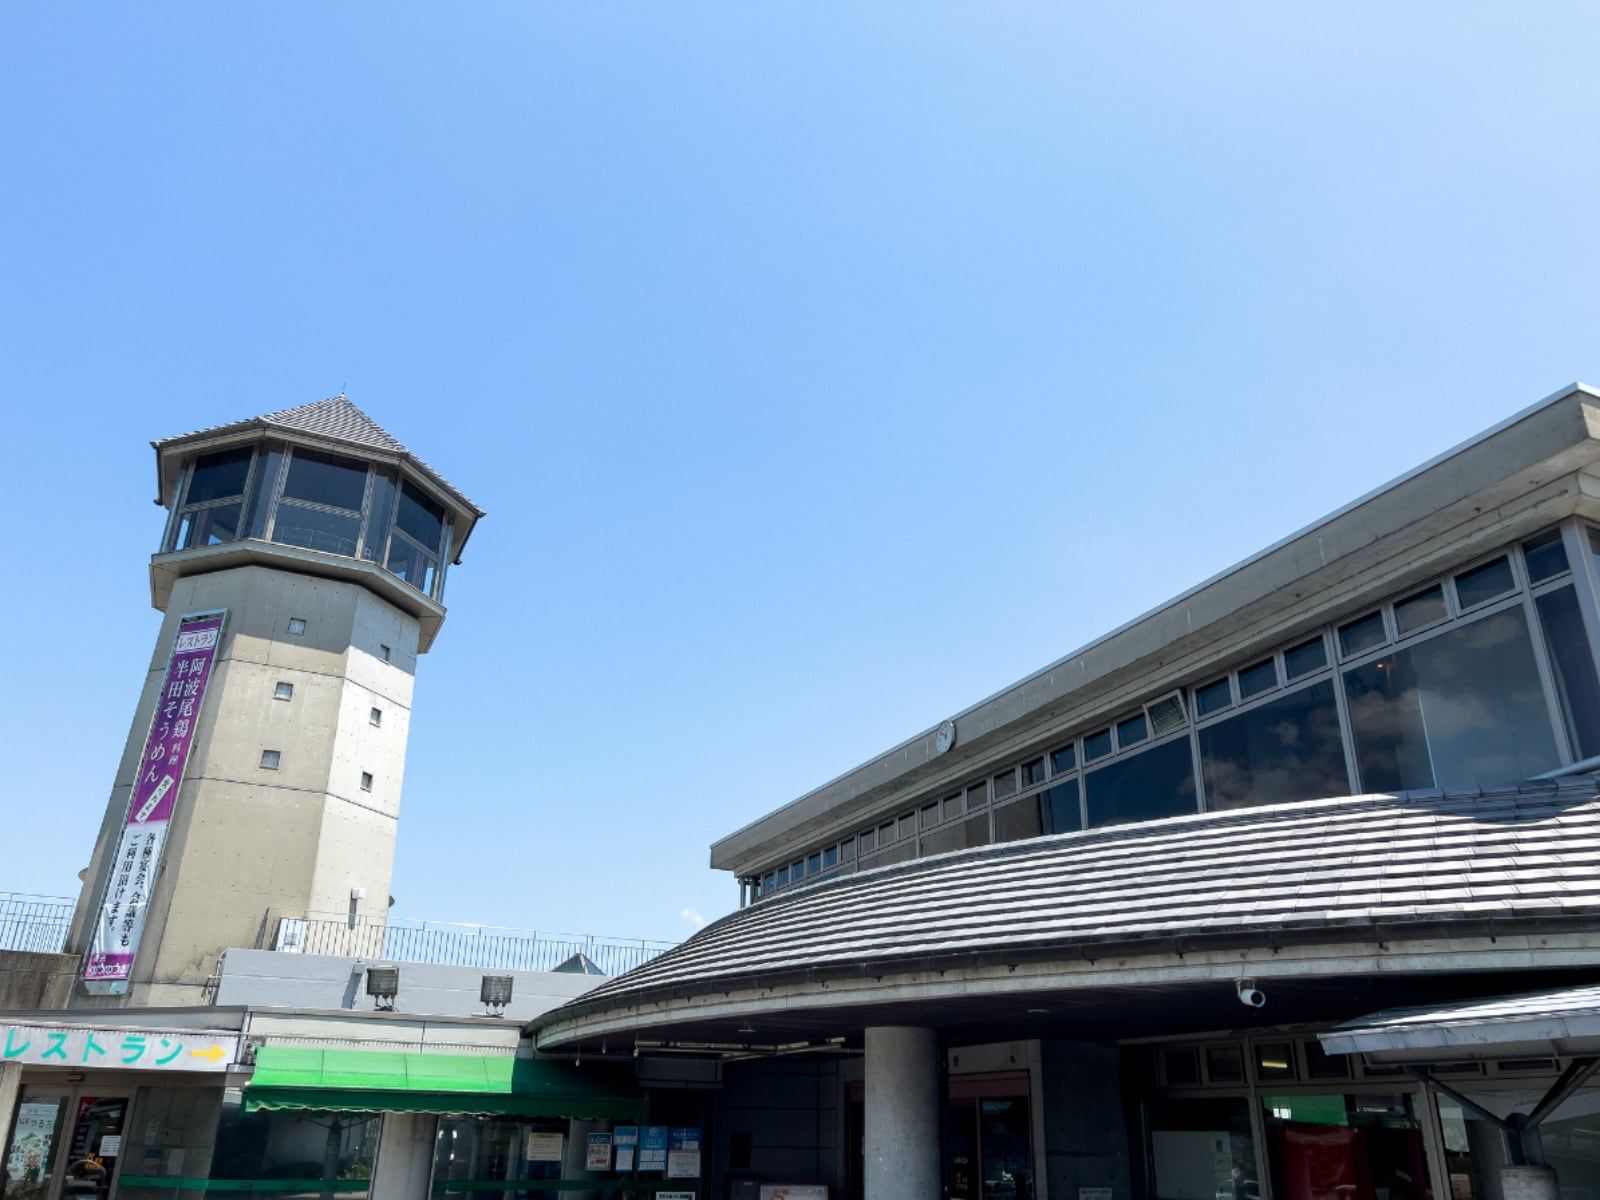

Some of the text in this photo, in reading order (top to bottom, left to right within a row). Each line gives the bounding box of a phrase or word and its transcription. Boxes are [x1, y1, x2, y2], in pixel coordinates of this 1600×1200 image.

[178, 633, 215, 649] レストラン
[144, 659, 189, 783] 半田そうめん
[3, 1029, 184, 1065] レストラン
